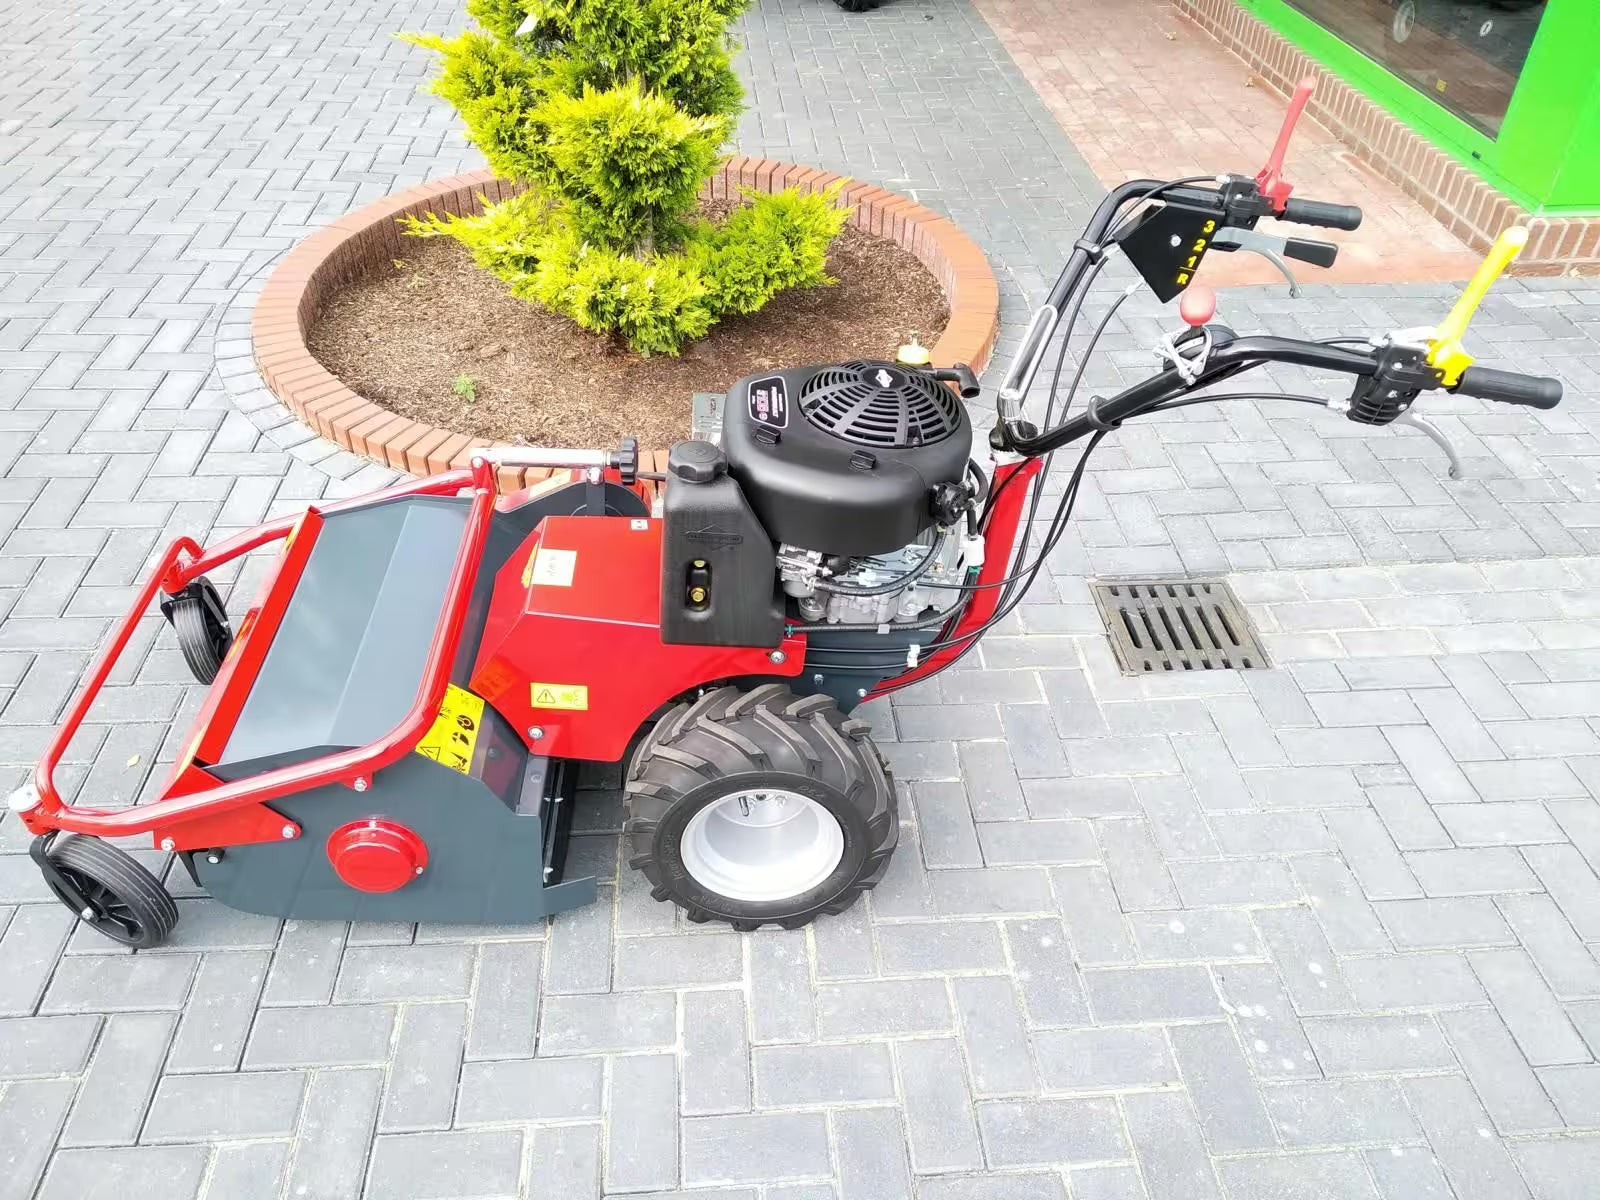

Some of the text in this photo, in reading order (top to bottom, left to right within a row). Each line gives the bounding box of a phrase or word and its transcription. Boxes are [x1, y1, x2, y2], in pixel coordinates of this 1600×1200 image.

[1204, 220, 1216, 232] 3
[1193, 239, 1206, 252] 2
[1188, 256, 1197, 268] 1
[1177, 273, 1189, 284] R
